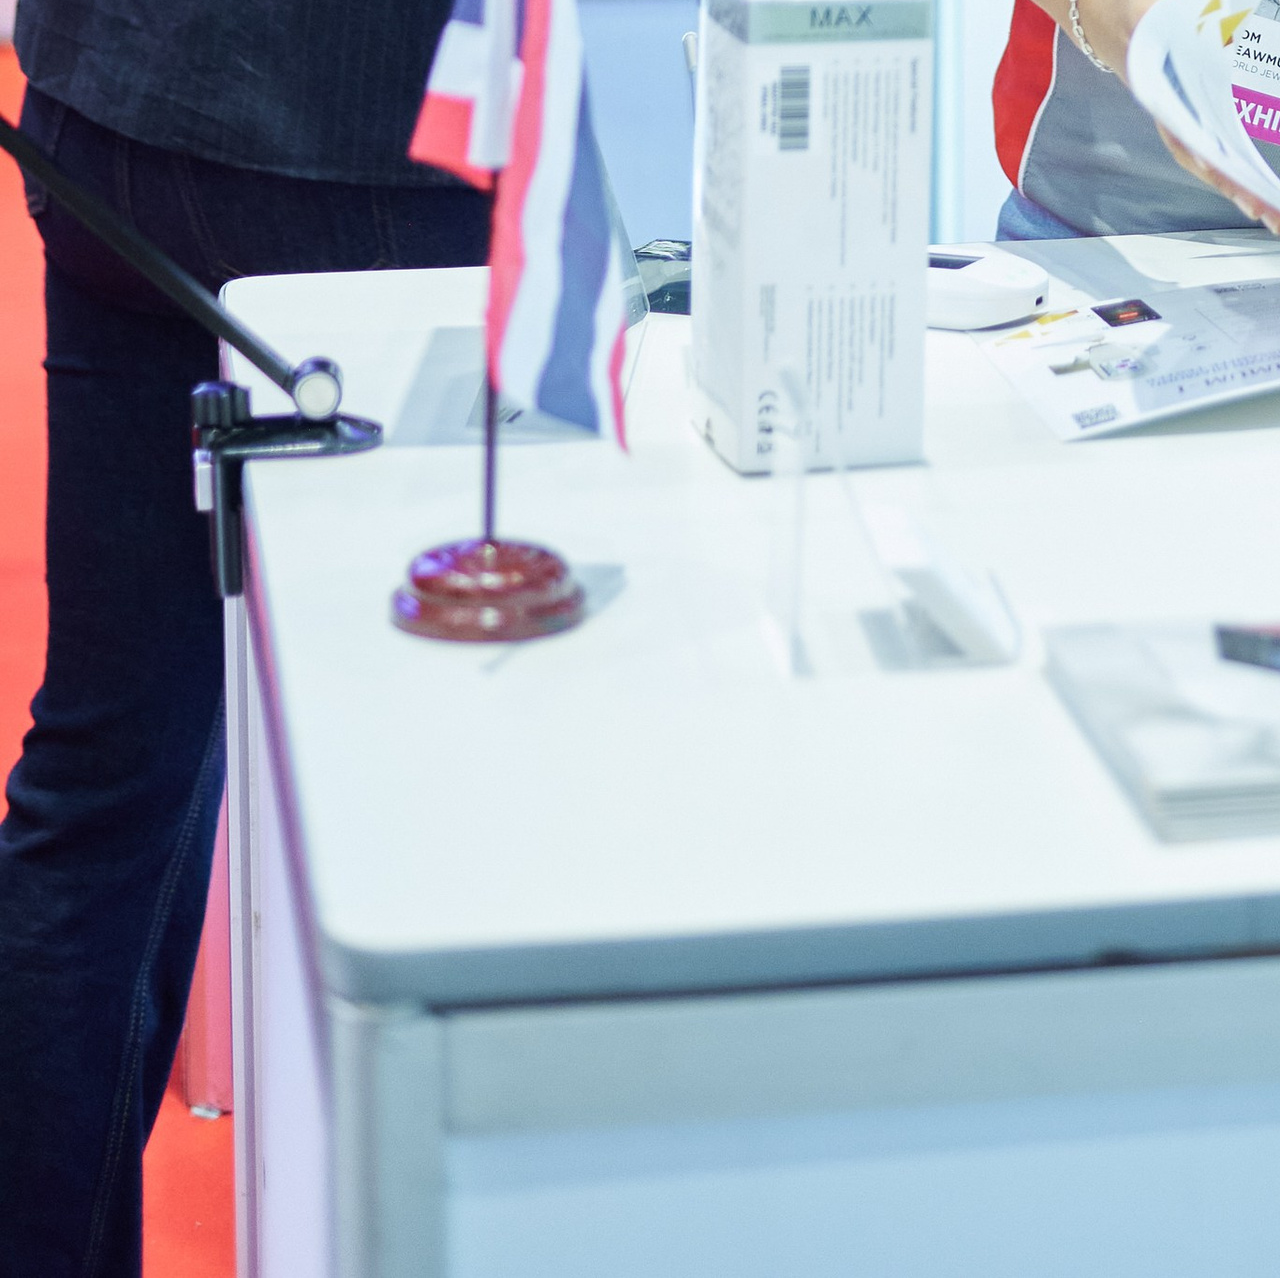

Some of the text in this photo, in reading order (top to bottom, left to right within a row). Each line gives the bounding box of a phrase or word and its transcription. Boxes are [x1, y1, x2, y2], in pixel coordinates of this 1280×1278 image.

[809, 5, 874, 29] MAX
[1242, 29, 1262, 43] OM
[1232, 59, 1259, 74] ORLD
